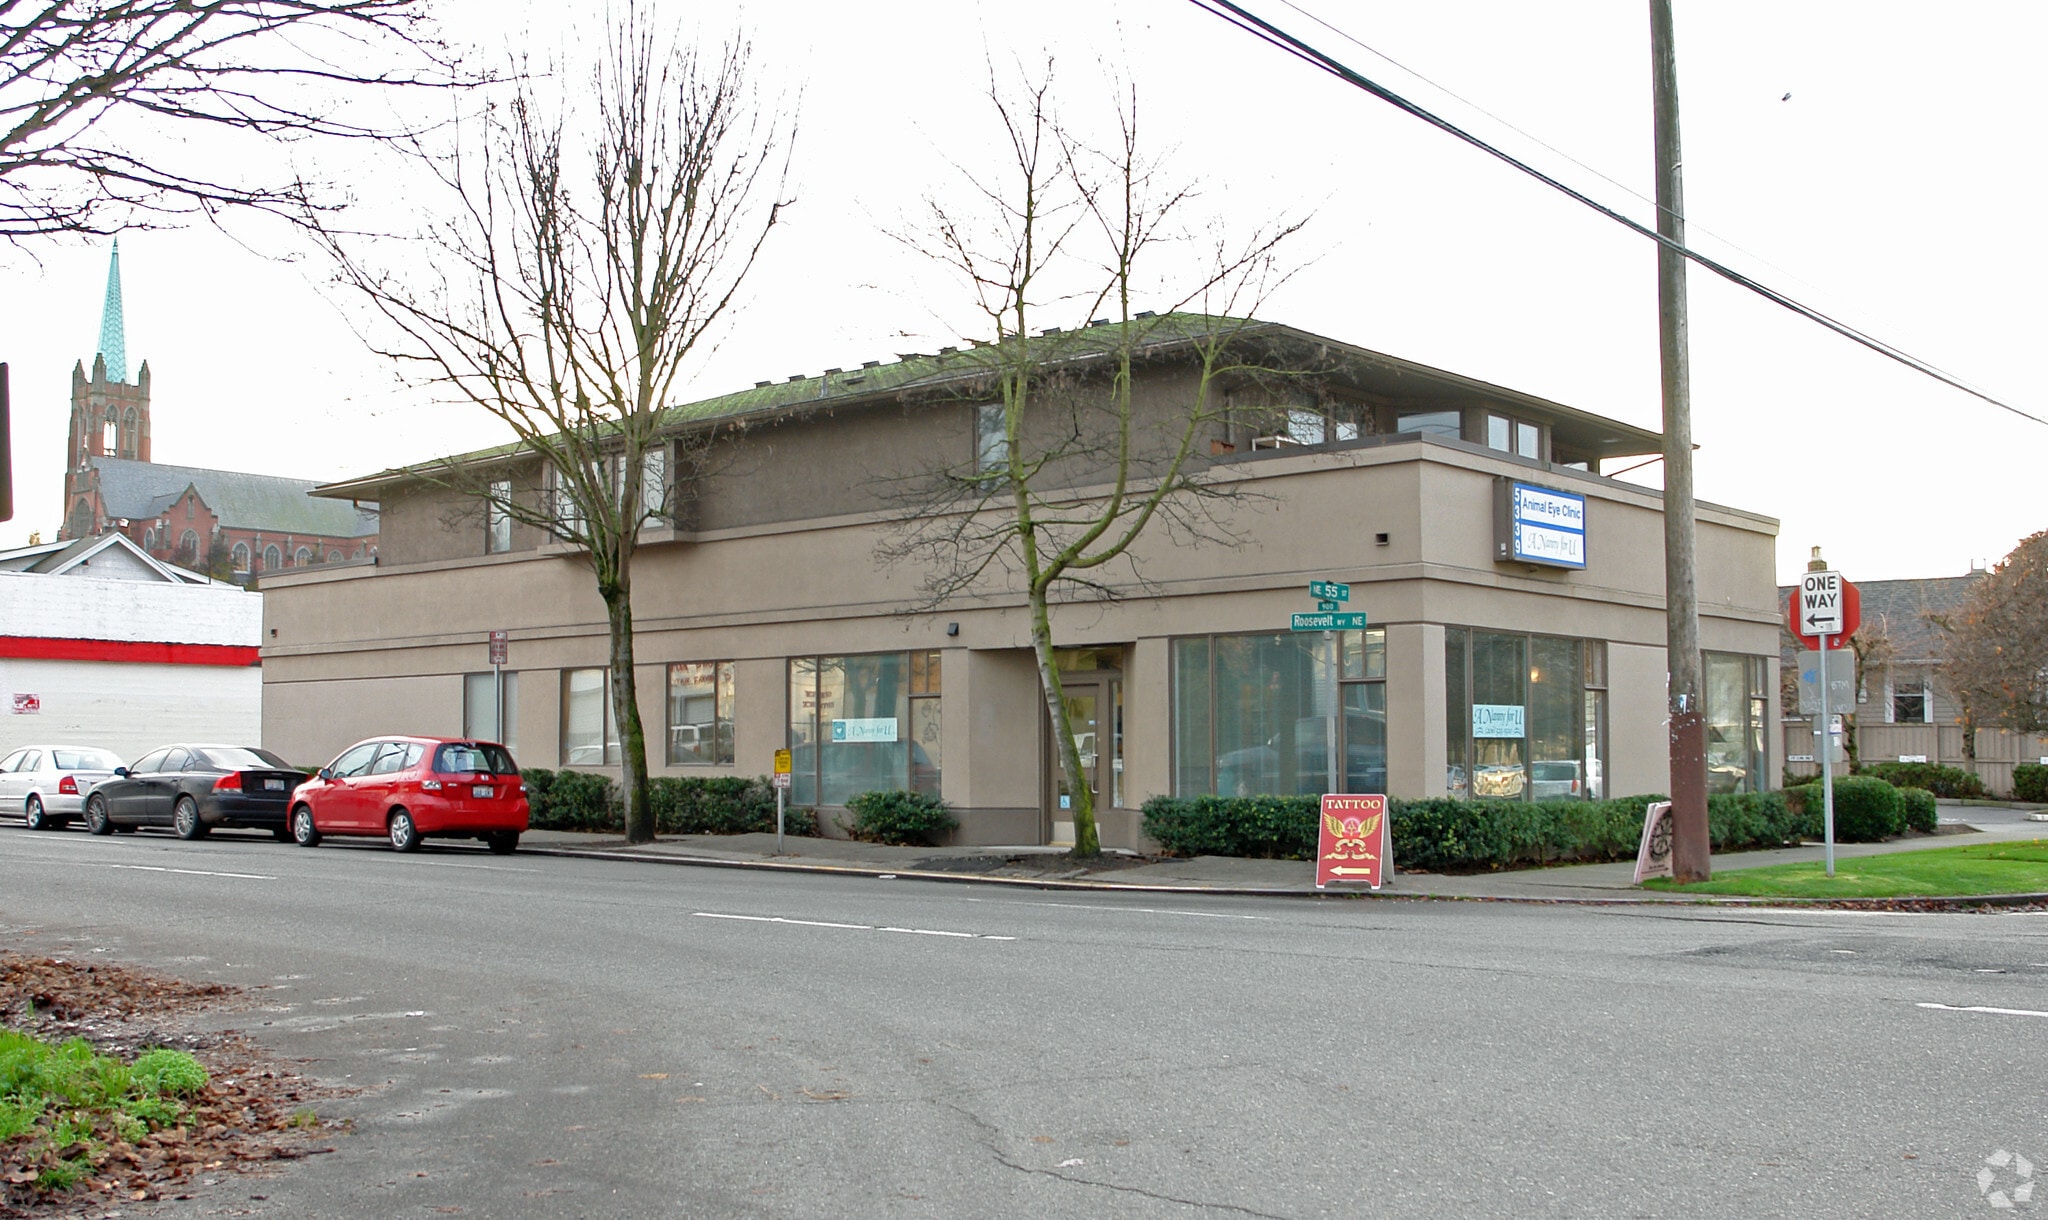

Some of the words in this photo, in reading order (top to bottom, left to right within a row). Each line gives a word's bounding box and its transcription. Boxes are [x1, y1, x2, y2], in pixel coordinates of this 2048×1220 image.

[1522, 497, 1547, 514] Animal
[1548, 502, 1560, 518] Eye
[1562, 504, 1581, 520] Clinic
[1527, 532, 1537, 550] A
[1537, 534, 1560, 554] Nanny
[1569, 538, 1577, 556] U
[1313, 585, 1322, 595] NE
[1325, 585, 1338, 597] 55
[1805, 576, 1836, 591] ONE
[1805, 593, 1837, 609] WAY
[1294, 615, 1333, 627] Roosevelt
[1352, 616, 1363, 626] NE
[1515, 709, 1522, 725] U
[1326, 799, 1381, 809] TATTOO
